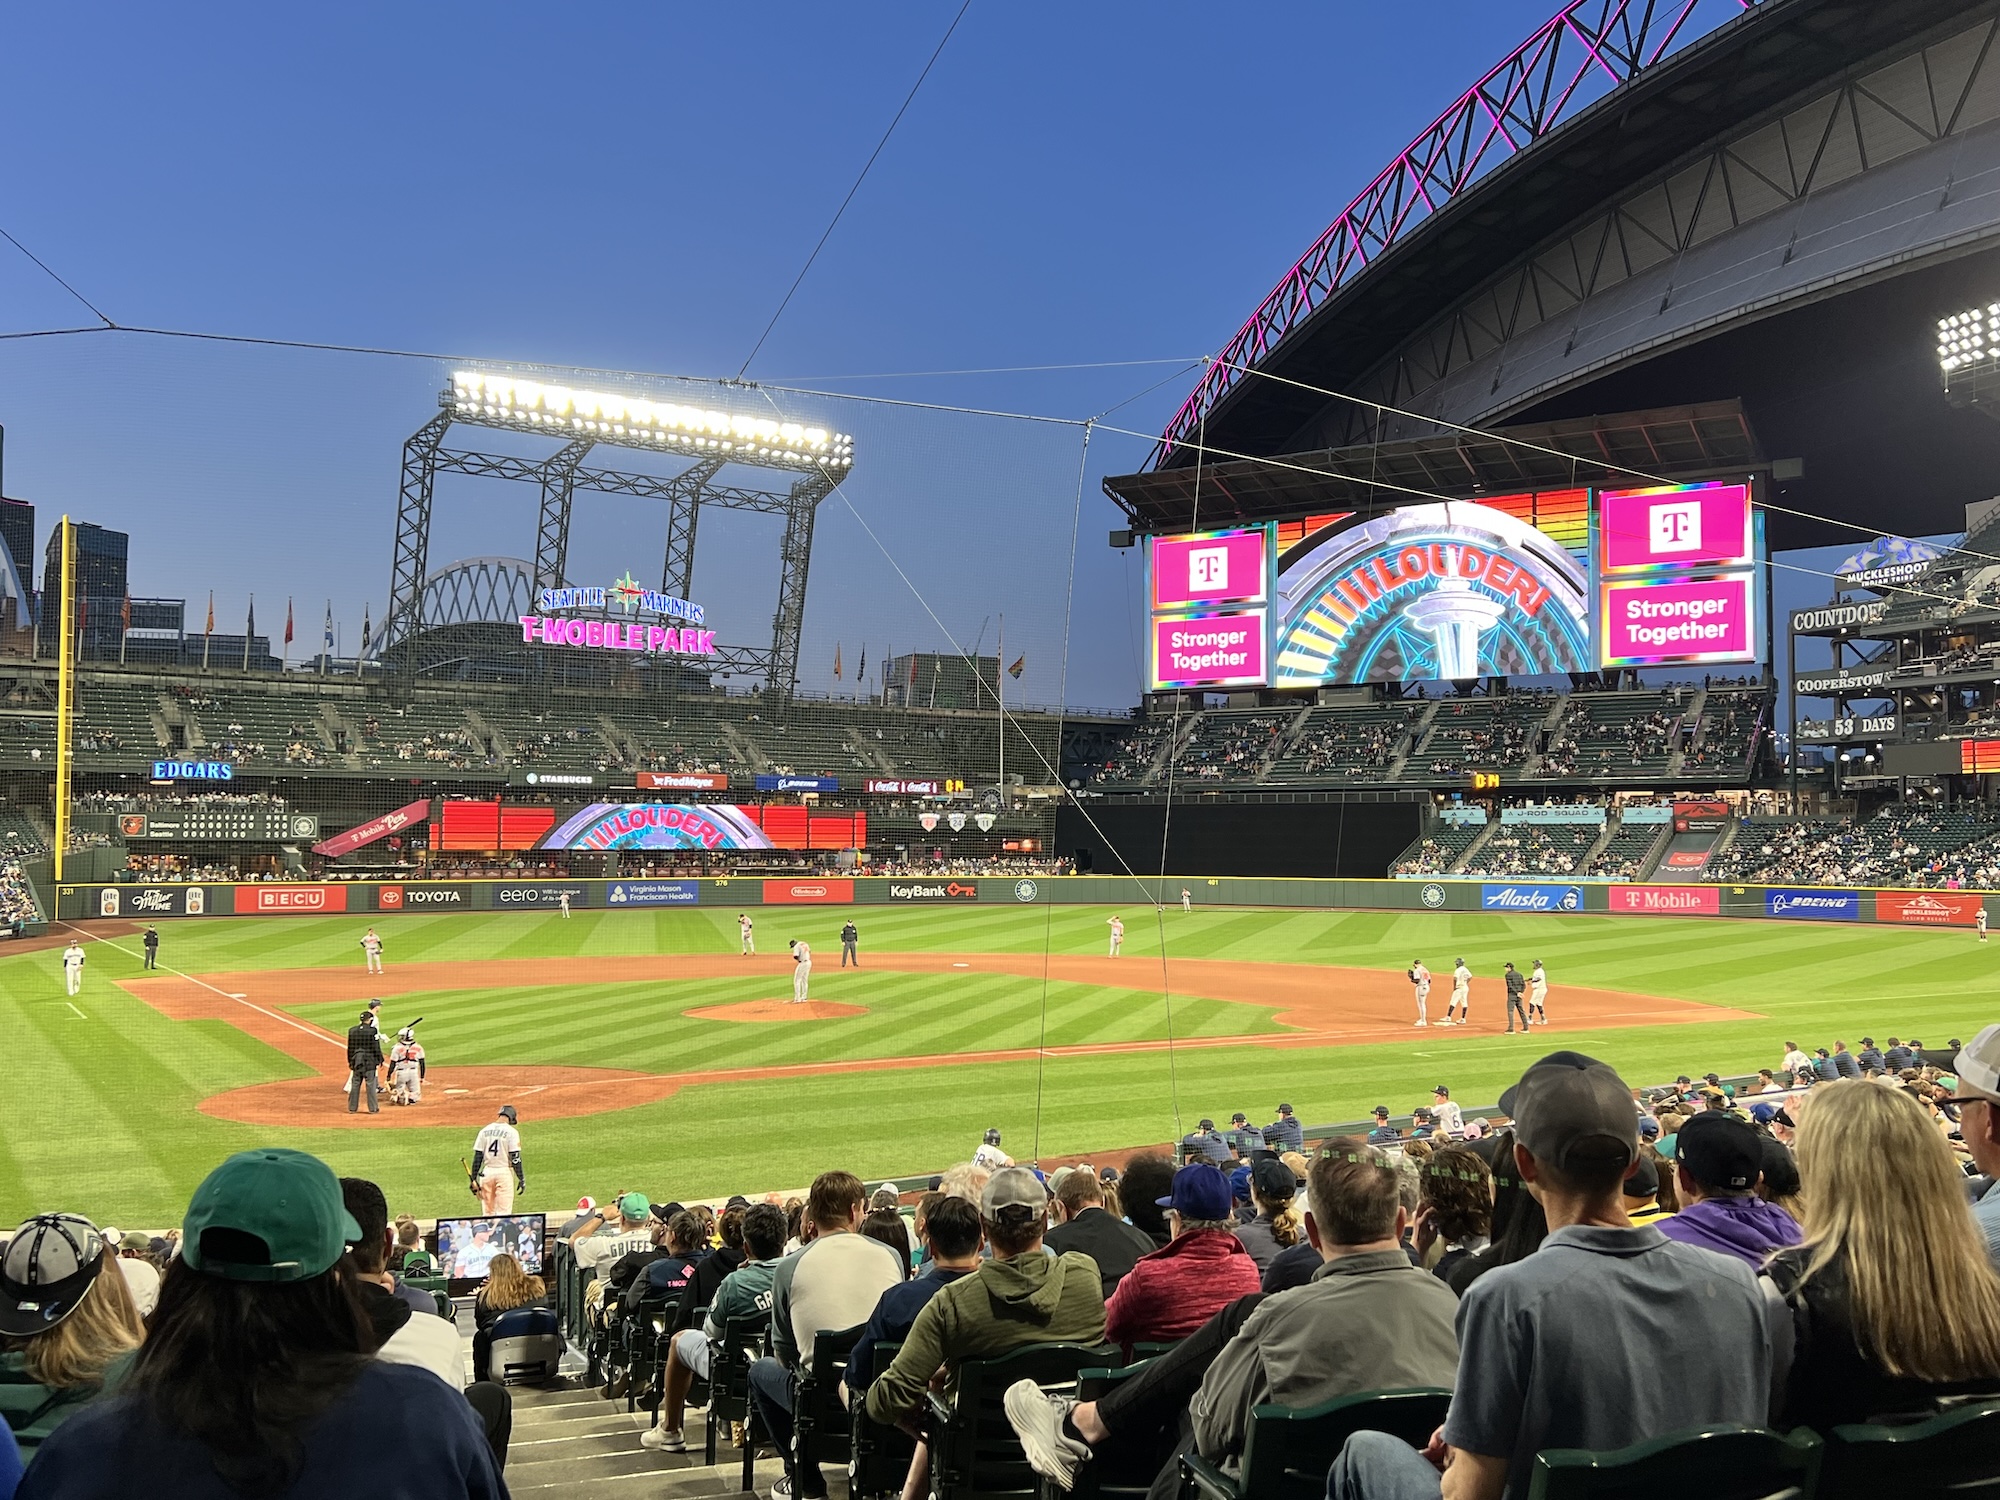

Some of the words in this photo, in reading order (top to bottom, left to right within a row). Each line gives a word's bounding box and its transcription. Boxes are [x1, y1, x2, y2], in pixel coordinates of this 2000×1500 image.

[1371, 543, 1552, 617] LOUDER!
[1846, 562, 1930, 583] MUCKLESHOOT
[540, 586, 606, 611] SEATTLE
[640, 588, 705, 624] MARINERS
[1626, 598, 1728, 619] Stronger
[519, 615, 644, 651] T-MOBILE
[648, 625, 717, 655] PARK
[1171, 631, 1248, 648] Stronger
[1625, 621, 1729, 646] Together
[1170, 650, 1248, 671] Together
[1839, 670, 1849, 678] TO
[1834, 719, 1854, 736] 53
[1861, 717, 1895, 732] DAYS
[539, 775, 593, 784] STARBUCKS
[787, 780, 819, 788] BOEING
[360, 824, 385, 840] Mobile
[614, 806, 726, 849] LOUDER!
[629, 885, 657, 894] Virginia
[715, 879, 728, 887] 376
[62, 888, 74, 896] 331
[407, 892, 461, 902] TOYOTA
[500, 889, 539, 902] eero
[629, 893, 668, 901] Franciscan
[890, 885, 946, 899] KeyBank
[1486, 887, 1550, 909] Alaska
[1644, 892, 1701, 908] Mobile
[132, 893, 173, 910] Miller
[150, 903, 172, 911] TIME
[1791, 897, 1848, 908] BOEING
[1902, 909, 1950, 917] MUCKLESHOOT
[1452, 1114, 1460, 1129] 6
[488, 1139, 498, 1157] 4
[610, 1240, 653, 1258] GRIFFE
